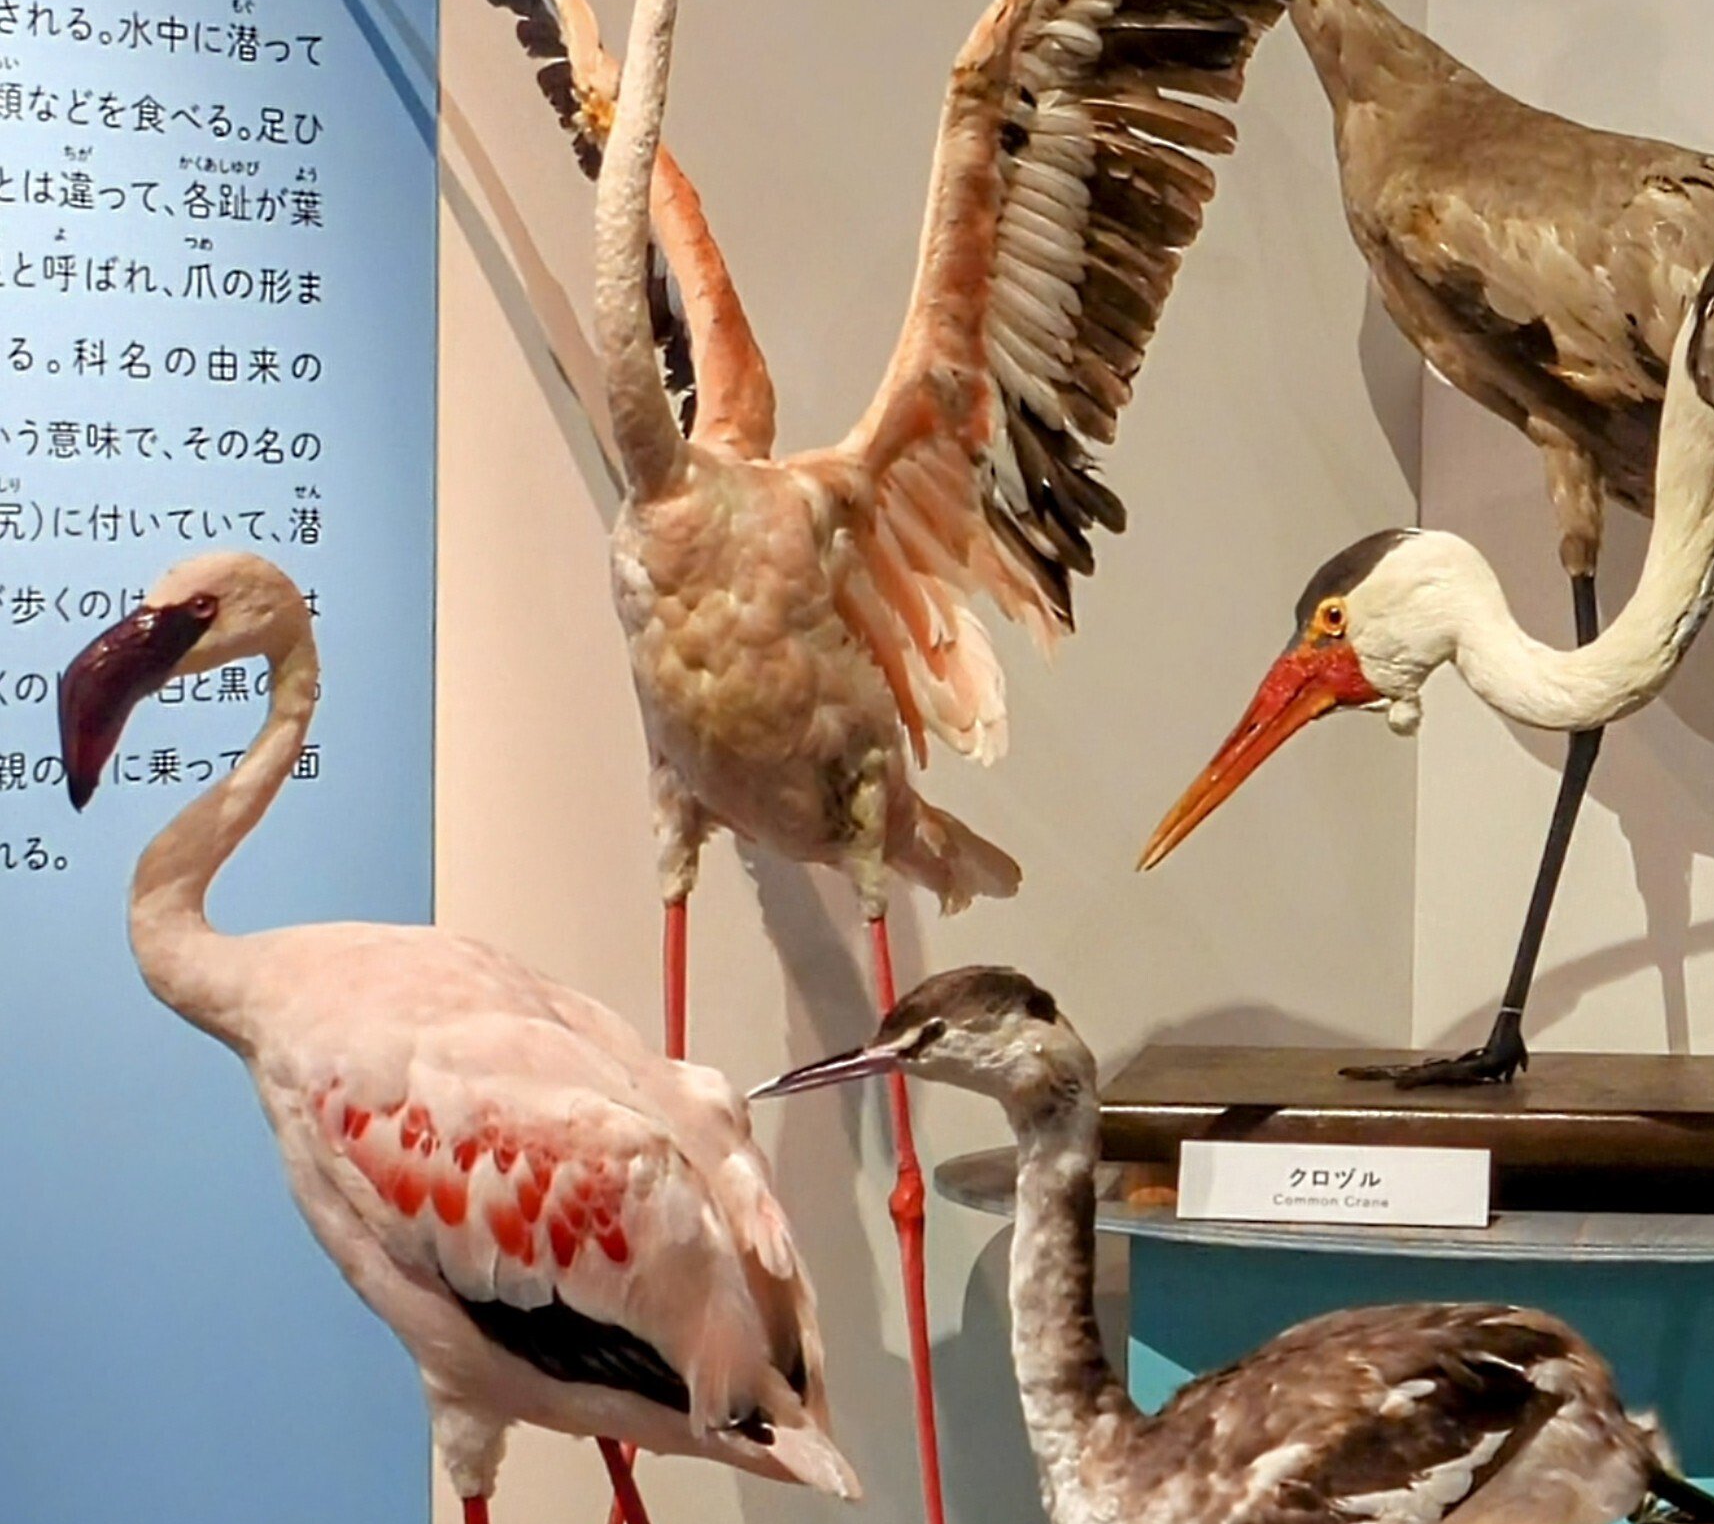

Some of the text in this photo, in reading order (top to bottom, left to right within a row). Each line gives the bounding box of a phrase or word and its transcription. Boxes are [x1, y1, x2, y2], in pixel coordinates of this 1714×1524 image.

[0, 251, 322, 304] と呼ばれ、爪の形ま
[7, 337, 322, 384] る。科名の由来の
[1289, 1167, 1382, 1189] クロヅル
[1272, 1192, 1390, 1209] Common Crane
